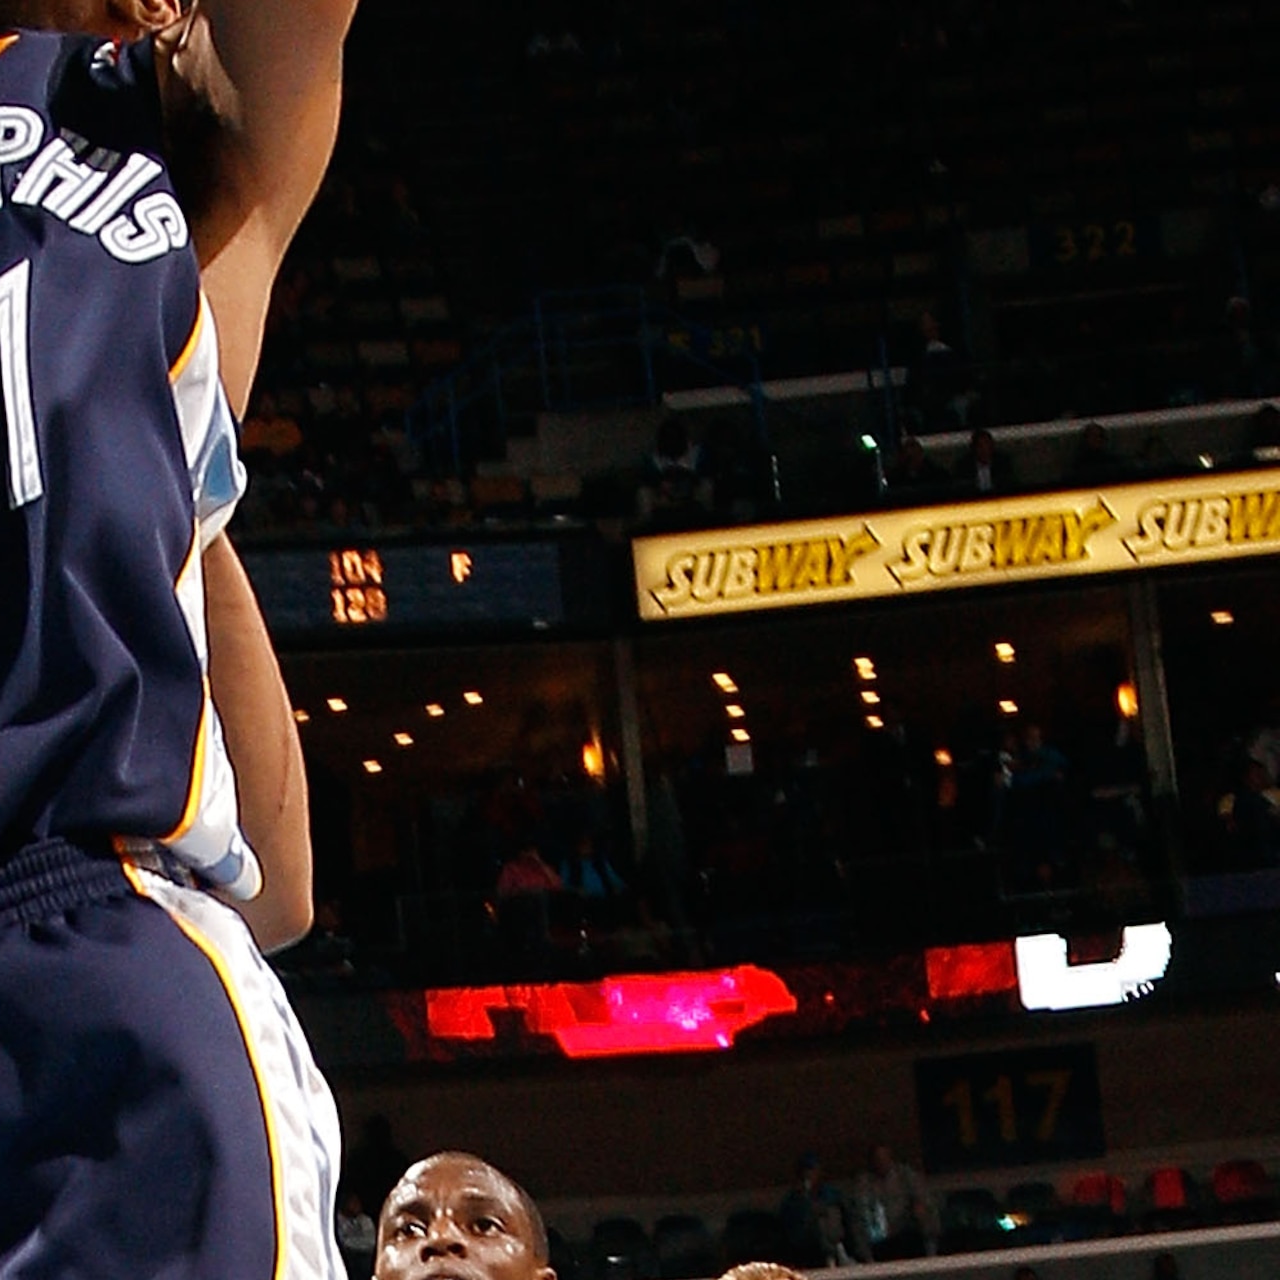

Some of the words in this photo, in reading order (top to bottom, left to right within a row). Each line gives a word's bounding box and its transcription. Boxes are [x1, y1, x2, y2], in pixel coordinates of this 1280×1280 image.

[1055, 217, 1138, 266] 322
[656, 529, 877, 609] SUBWAY
[894, 500, 1111, 583] SUBWAY
[941, 1068, 1075, 1146] 117
